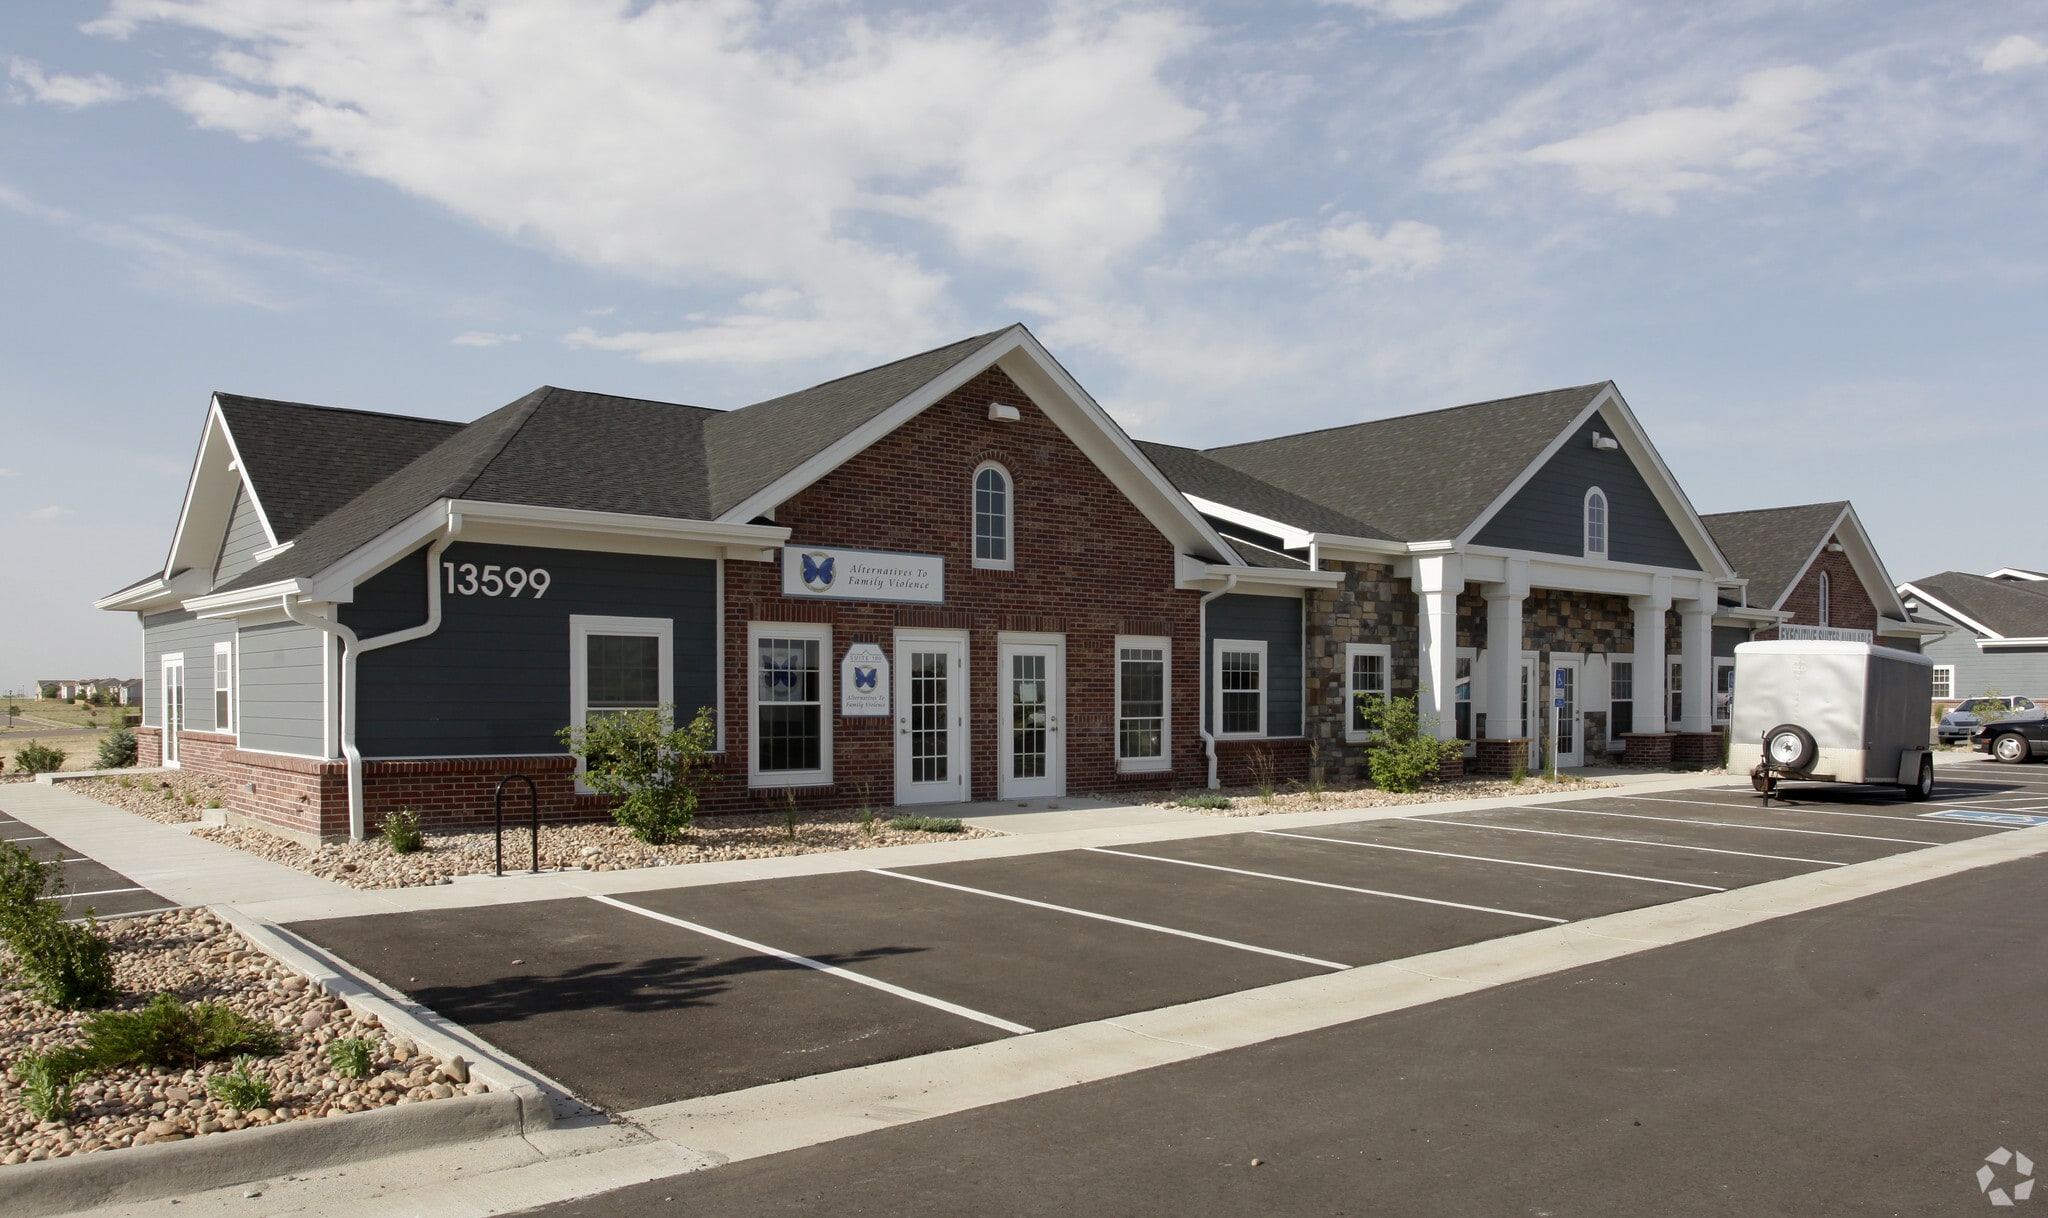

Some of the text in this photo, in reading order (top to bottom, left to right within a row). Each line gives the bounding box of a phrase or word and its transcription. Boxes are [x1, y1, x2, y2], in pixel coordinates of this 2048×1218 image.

[849, 564, 928, 578] Alternatives To
[443, 562, 551, 599] 13599
[848, 576, 930, 590] Family Violence
